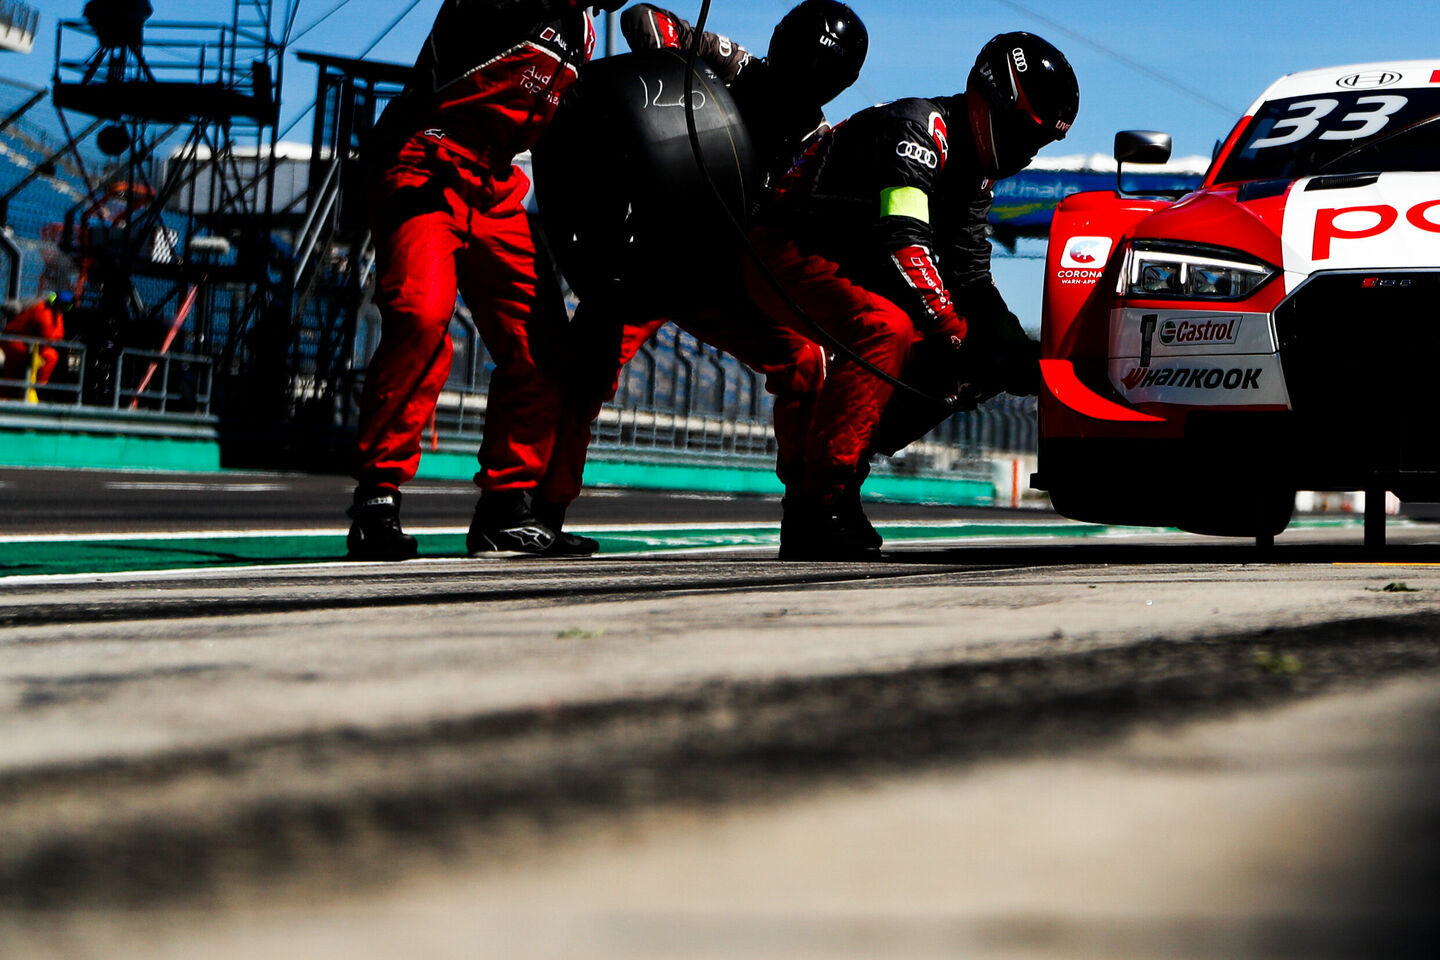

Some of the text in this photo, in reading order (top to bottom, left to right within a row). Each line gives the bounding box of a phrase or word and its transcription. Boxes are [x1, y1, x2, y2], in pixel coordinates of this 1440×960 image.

[1249, 95, 1409, 149] 33
[1057, 270, 1103, 279] CORONA
[1176, 320, 1236, 342] Castrol
